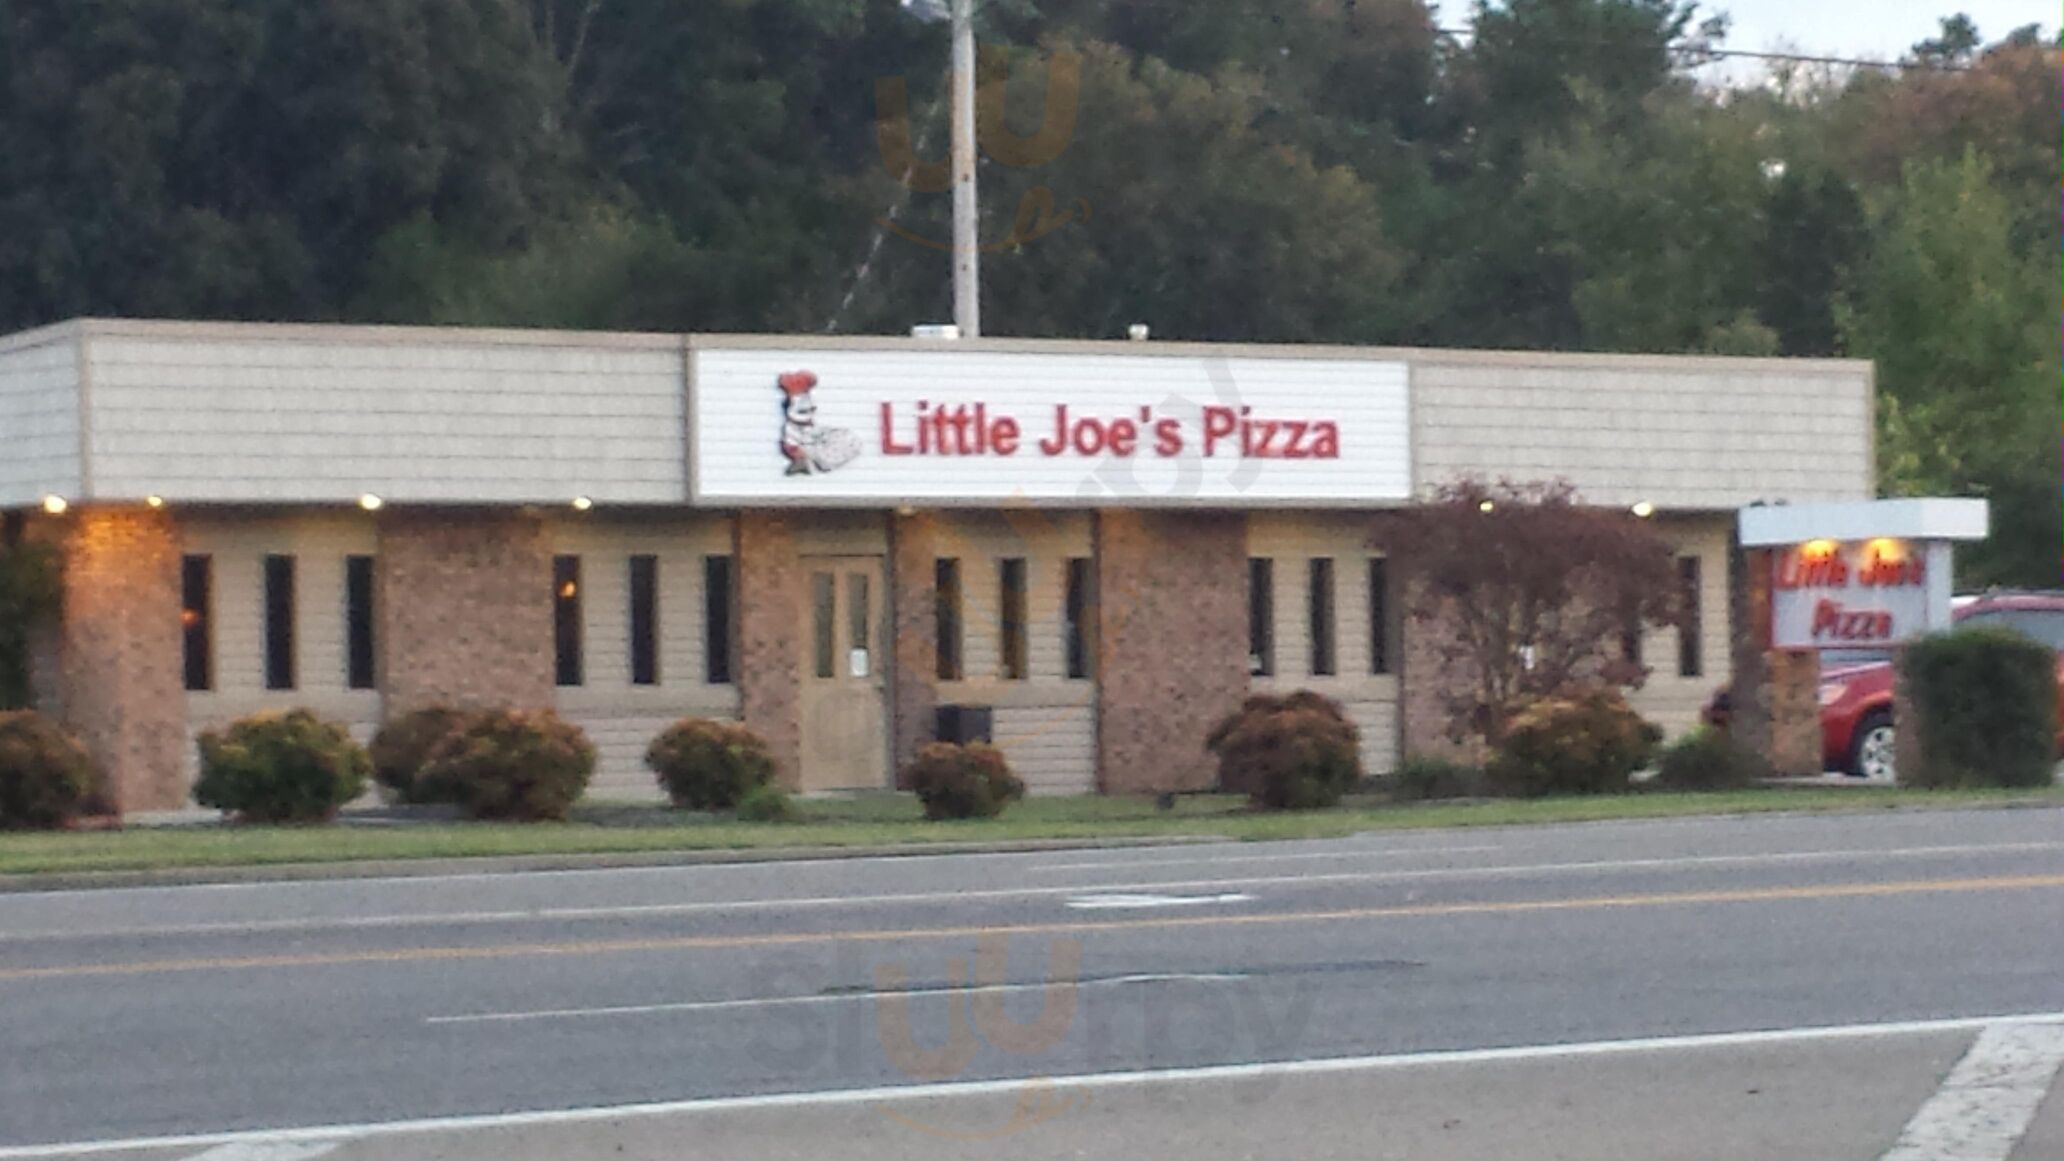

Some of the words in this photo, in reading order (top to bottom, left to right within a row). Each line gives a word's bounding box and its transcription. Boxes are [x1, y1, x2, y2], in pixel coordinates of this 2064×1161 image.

[880, 401, 1021, 454] Little
[1039, 404, 1182, 455] Joe's
[1203, 405, 1339, 457] Pizza
[1810, 597, 1893, 639] Pizza
